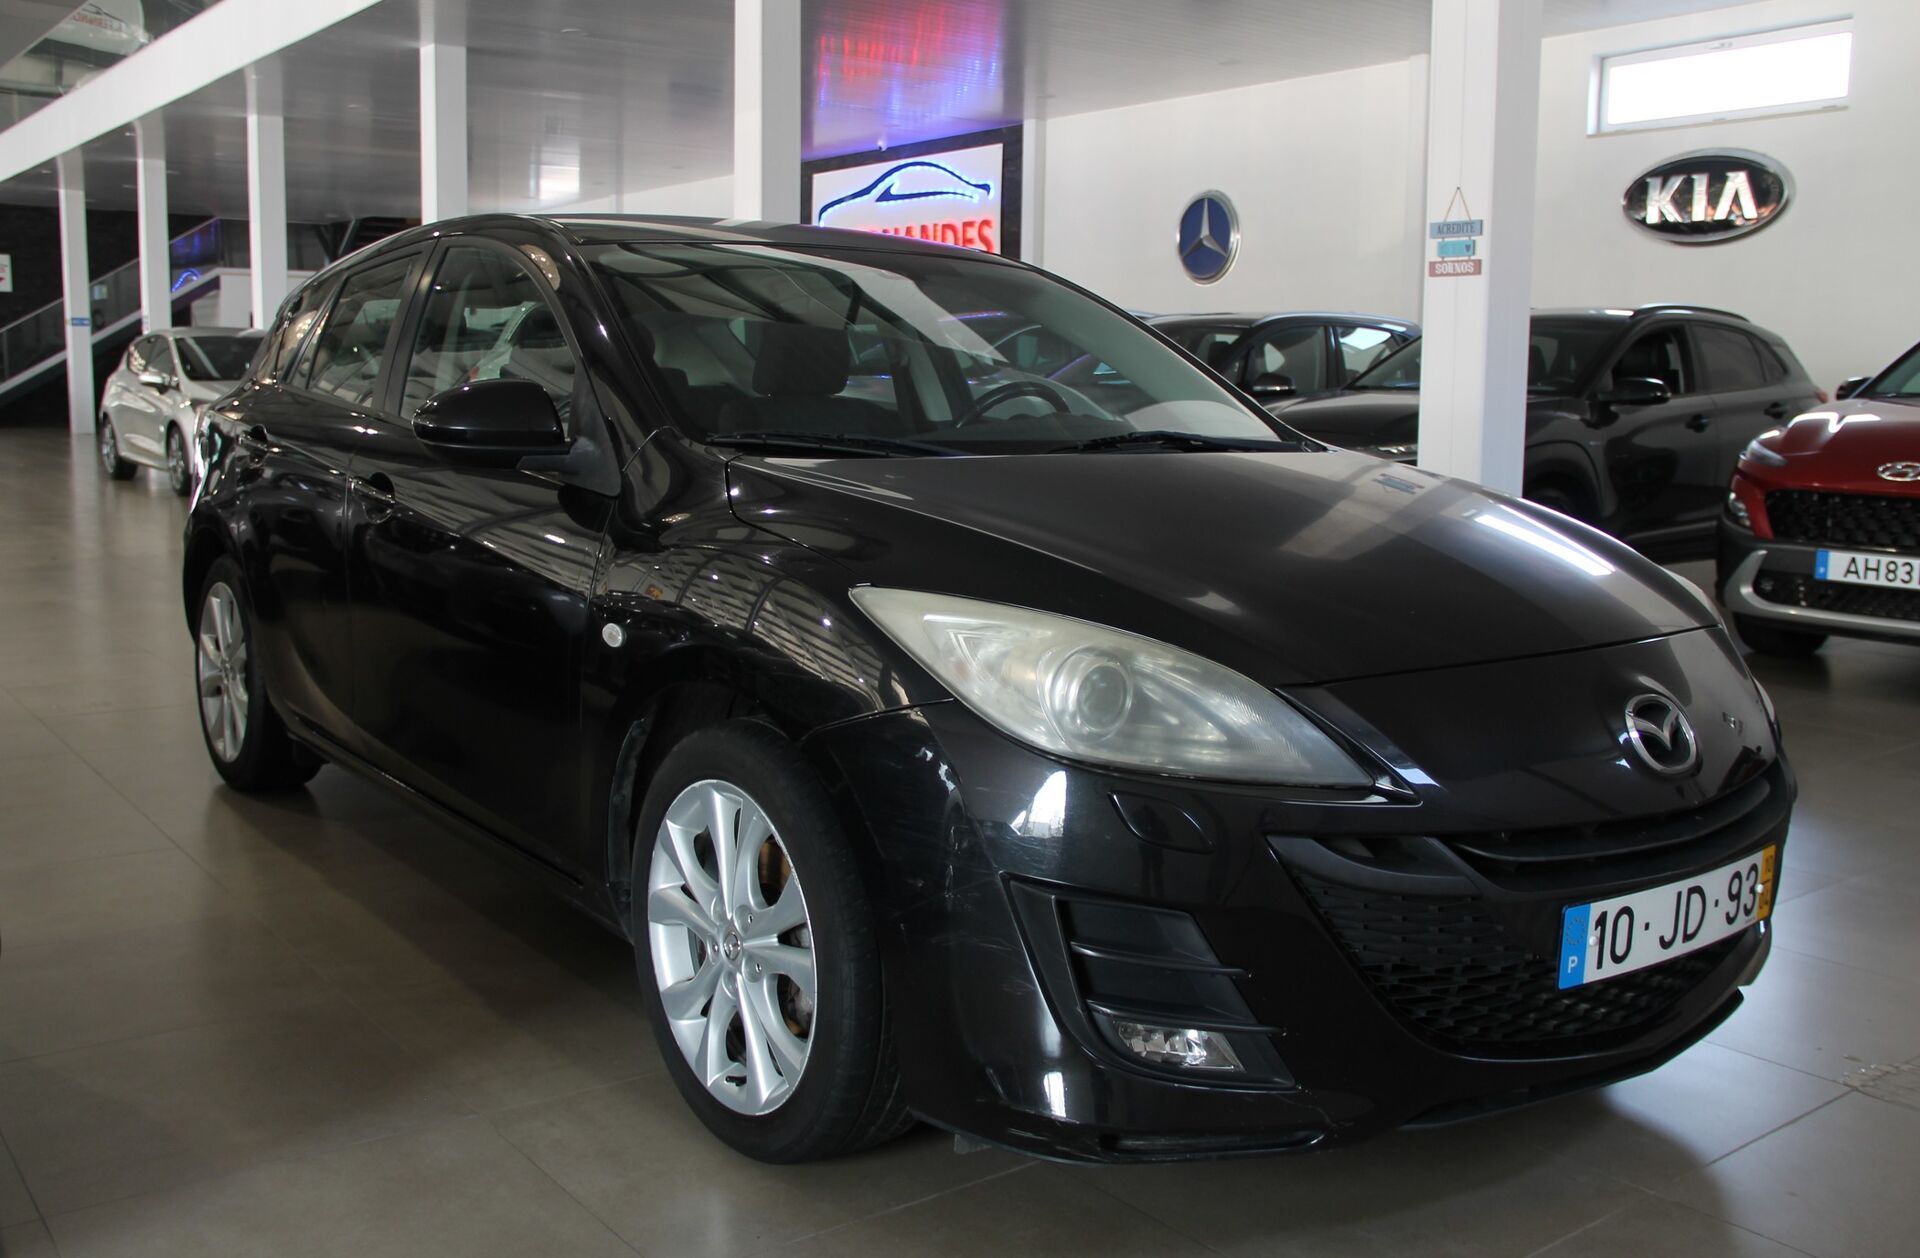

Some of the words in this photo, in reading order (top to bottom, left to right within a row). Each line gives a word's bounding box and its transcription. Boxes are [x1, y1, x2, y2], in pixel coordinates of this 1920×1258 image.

[1645, 170, 1758, 225] KIA
[1437, 222, 1475, 235] ACREDITE
[1567, 956, 1578, 973] P
